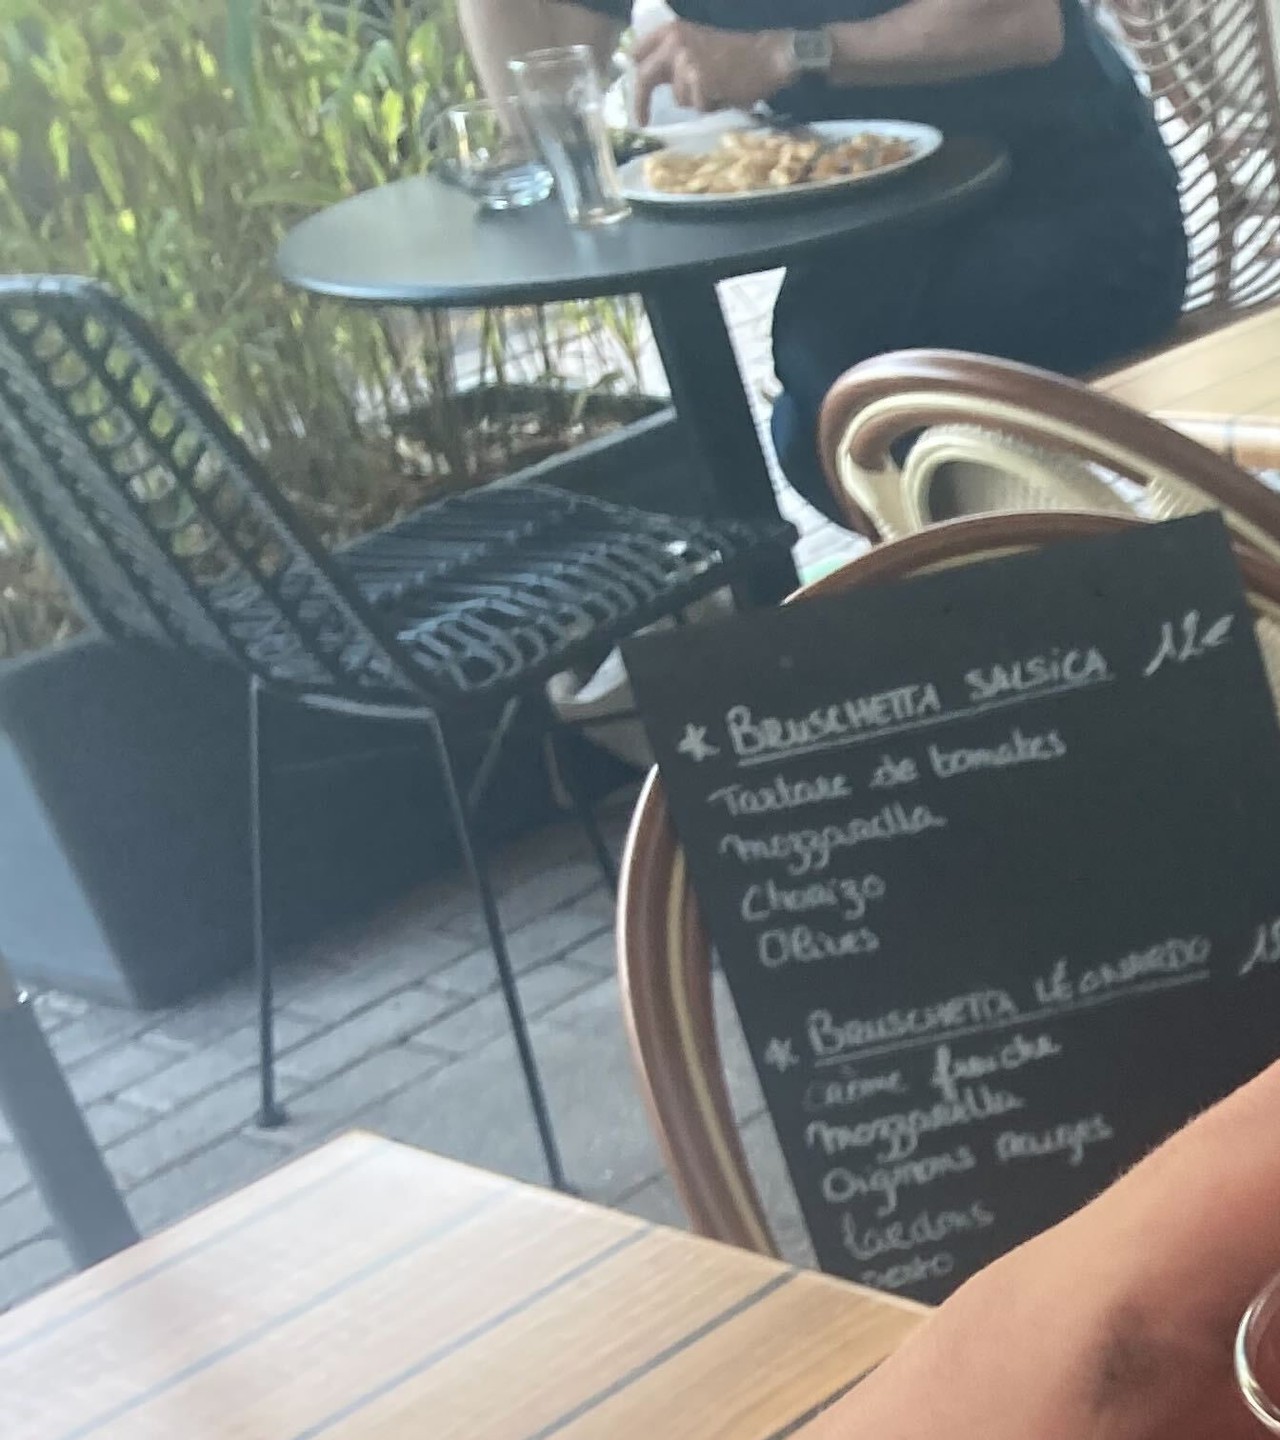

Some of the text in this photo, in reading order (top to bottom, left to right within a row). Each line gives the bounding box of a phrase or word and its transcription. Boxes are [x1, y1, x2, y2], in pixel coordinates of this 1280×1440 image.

[726, 684, 942, 755] BRUSCHETTA
[1143, 610, 1234, 678] 12€
[868, 753, 920, 789] de
[928, 728, 1068, 778] tomates
